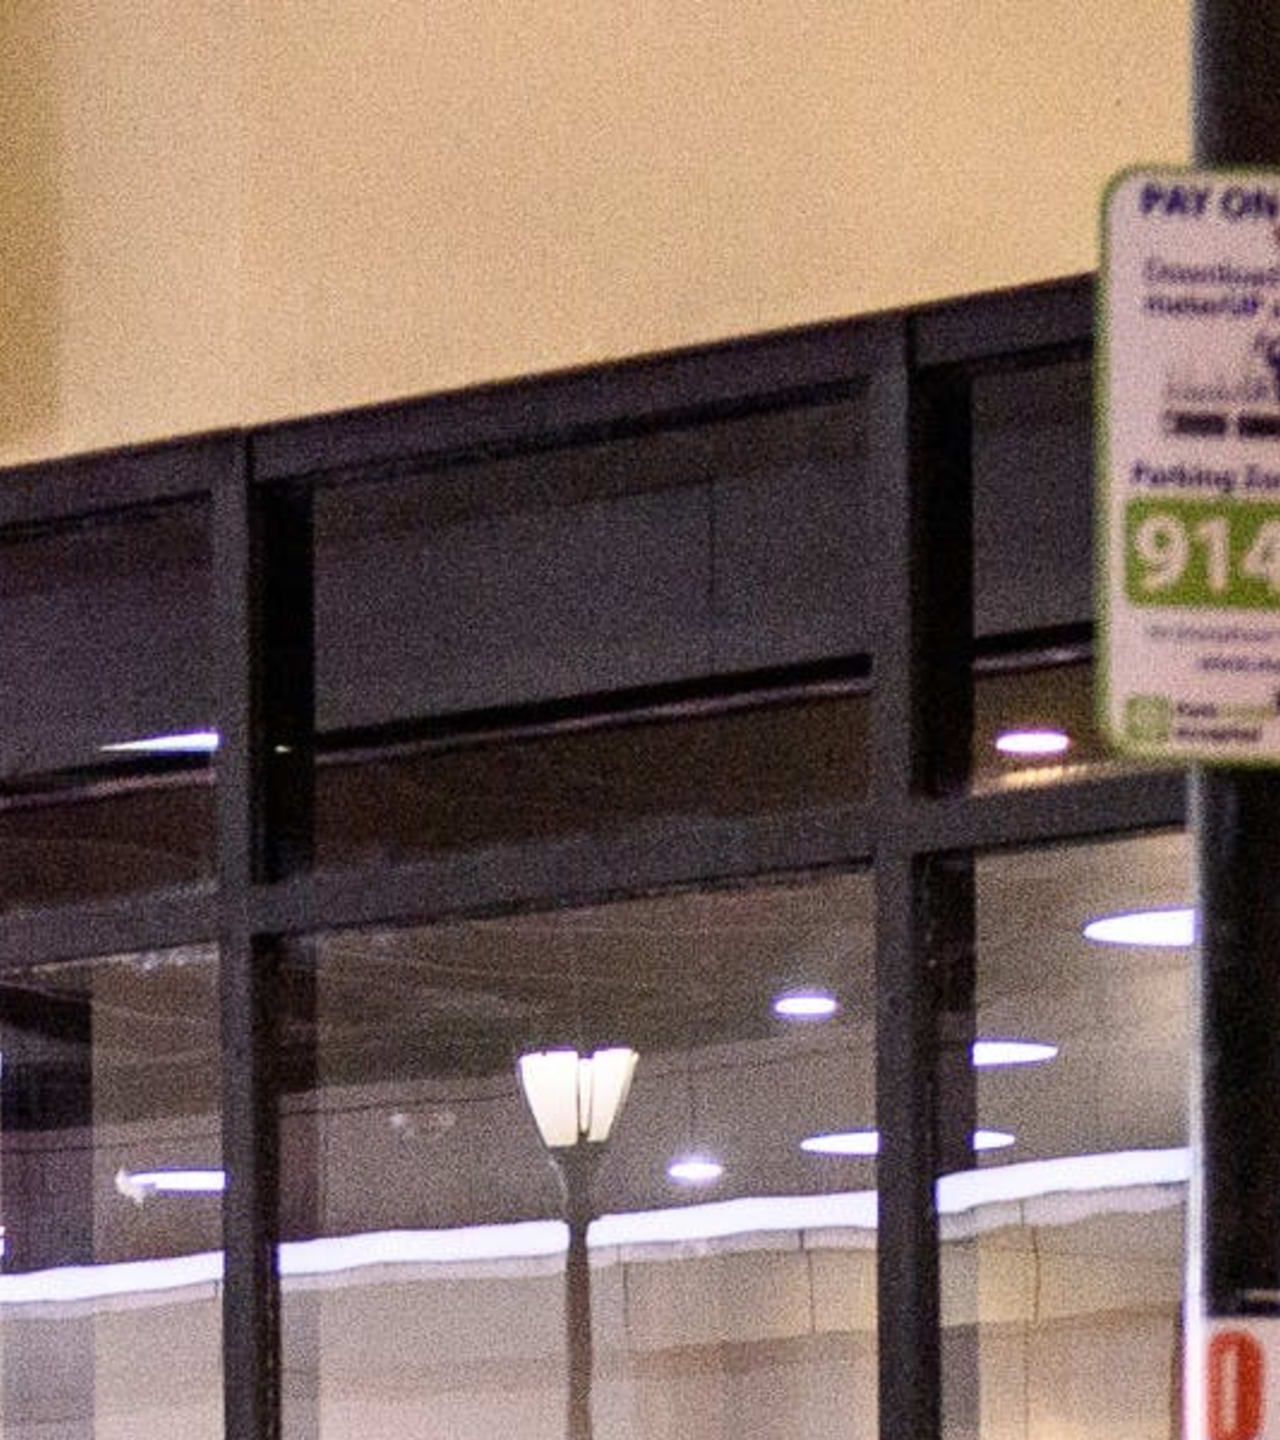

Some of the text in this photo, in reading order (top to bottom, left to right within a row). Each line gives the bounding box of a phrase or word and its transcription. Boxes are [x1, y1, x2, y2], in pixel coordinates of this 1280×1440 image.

[1139, 181, 1207, 216] PAY
[1221, 184, 1278, 219] ON
[1131, 458, 1235, 492] Parking
